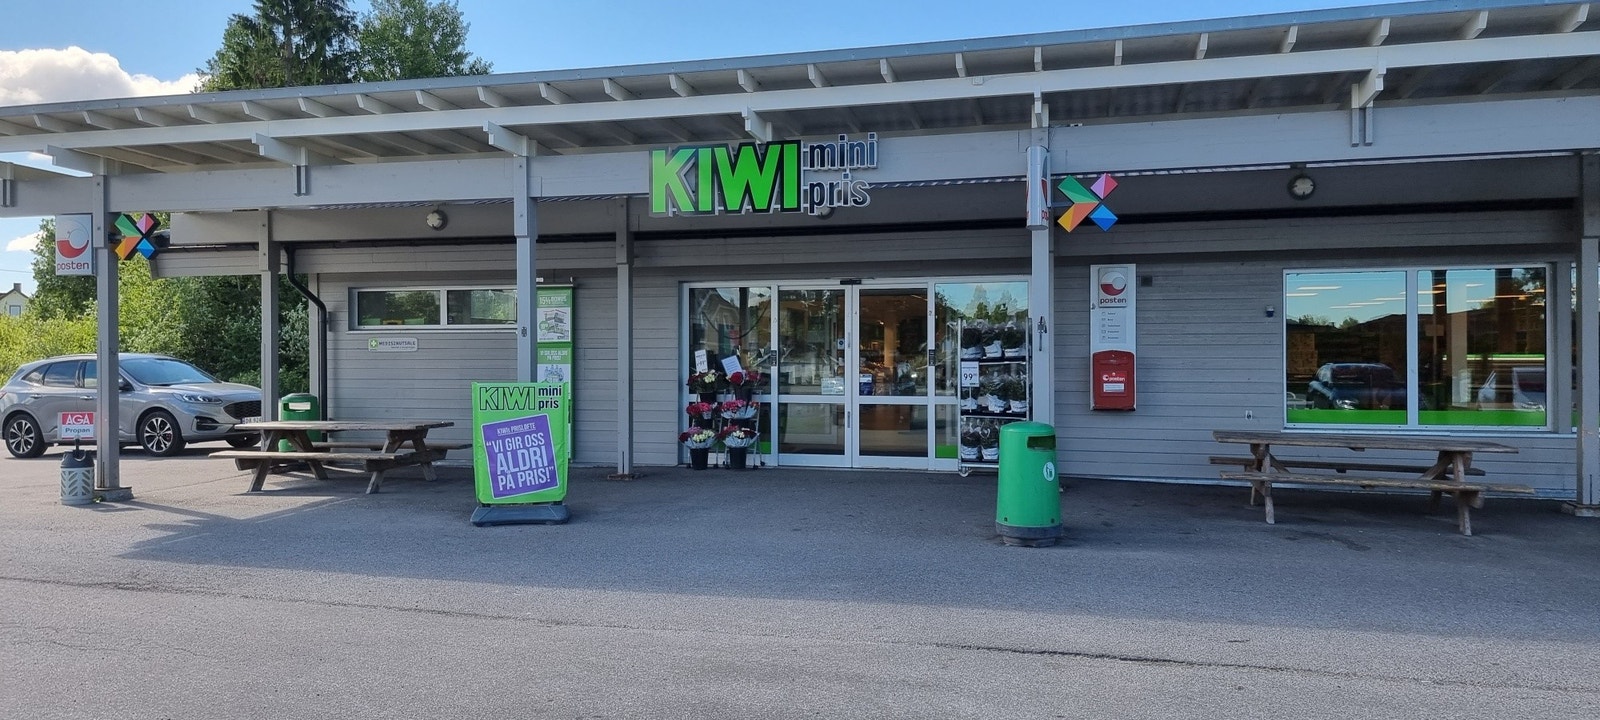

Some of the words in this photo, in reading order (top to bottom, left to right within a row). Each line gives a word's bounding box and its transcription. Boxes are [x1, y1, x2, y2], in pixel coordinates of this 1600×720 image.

[808, 133, 878, 170] mini
[650, 139, 802, 215] KIWI
[808, 172, 871, 215] pris
[57, 261, 90, 271] posten
[1100, 297, 1127, 305] posten
[480, 386, 535, 410] KIWI
[538, 385, 562, 396] mini
[538, 397, 559, 411] pris
[65, 413, 91, 425] AGA
[505, 436, 523, 451] GIR
[524, 432, 545, 448] OSS
[497, 445, 548, 475] ALDRI
[498, 471, 516, 491] PÅ
